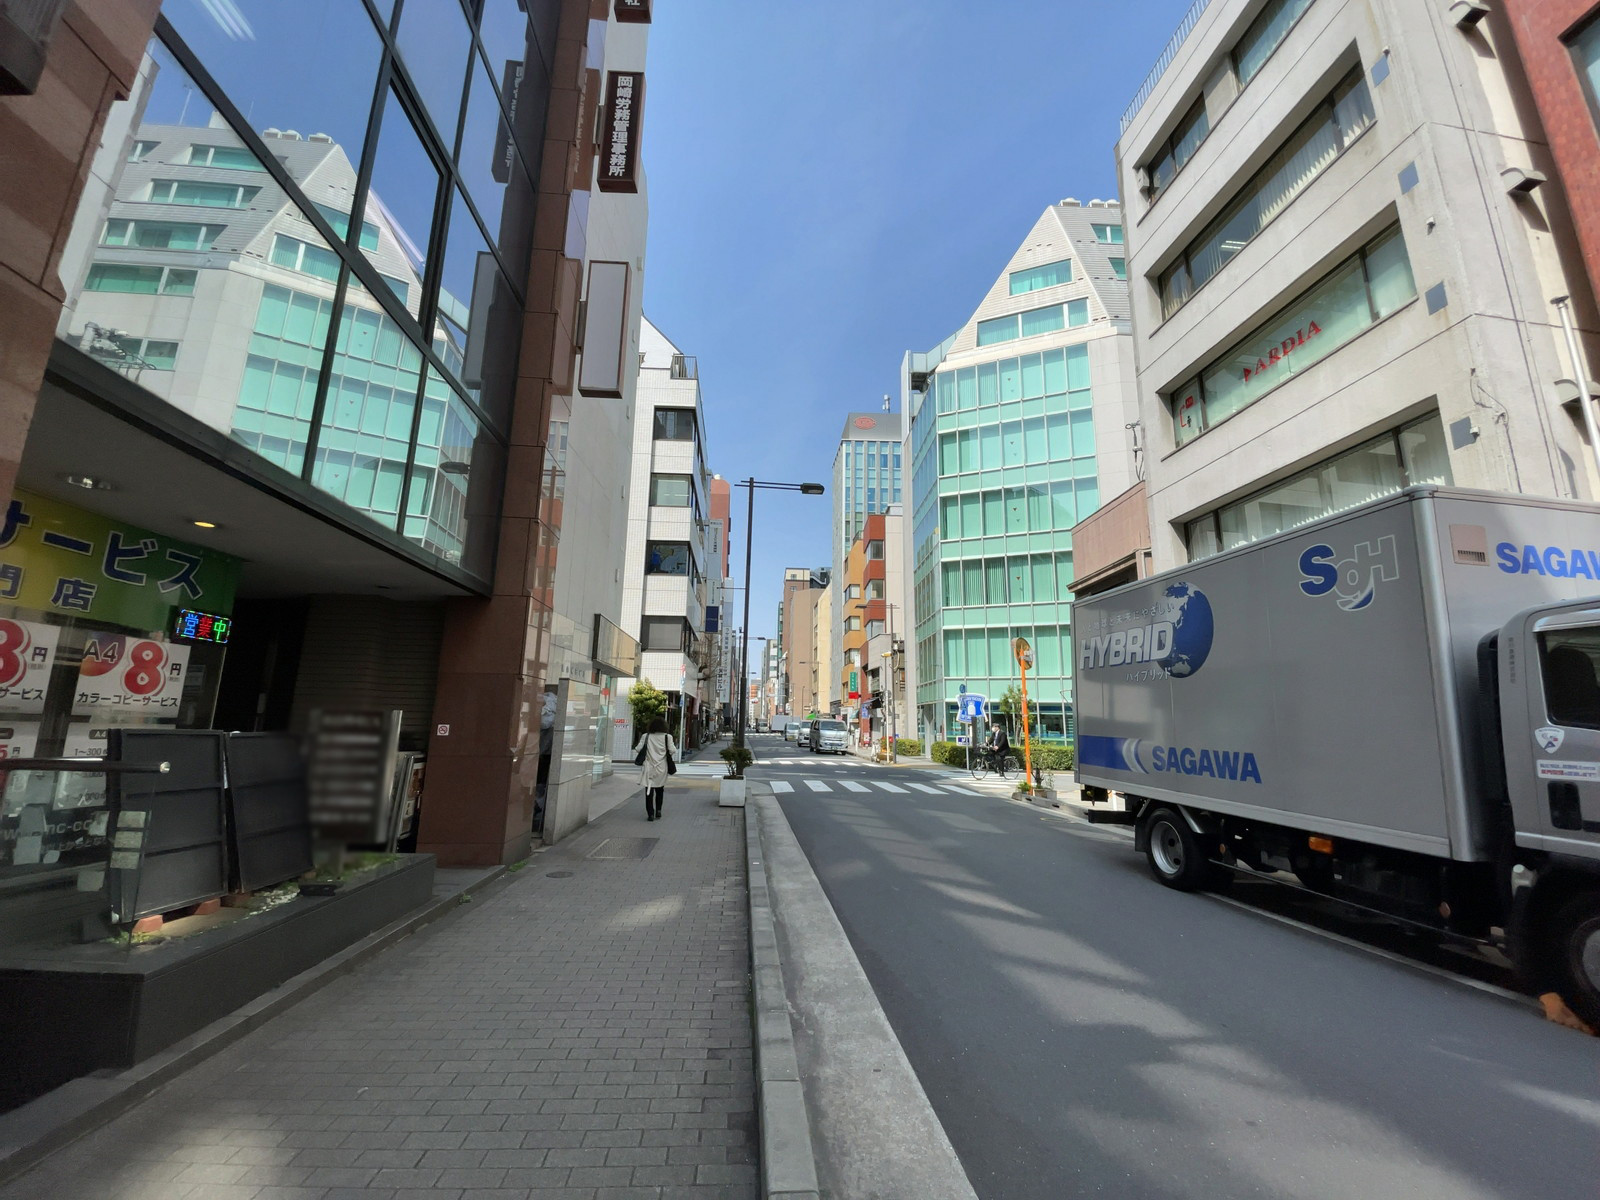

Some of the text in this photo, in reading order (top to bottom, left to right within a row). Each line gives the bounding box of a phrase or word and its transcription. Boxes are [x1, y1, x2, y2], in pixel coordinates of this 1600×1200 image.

[609, 76, 634, 177] 岡崎労務管理事務所
[184, 613, 226, 643] 営業中
[31, 646, 48, 662] 円
[82, 639, 118, 664] A4
[1080, 621, 1174, 670] HYBRID
[1126, 667, 1172, 682] ハイブリッド
[76, 692, 179, 707] カラーコピーサービス
[1152, 746, 1262, 784] SAGAWA
